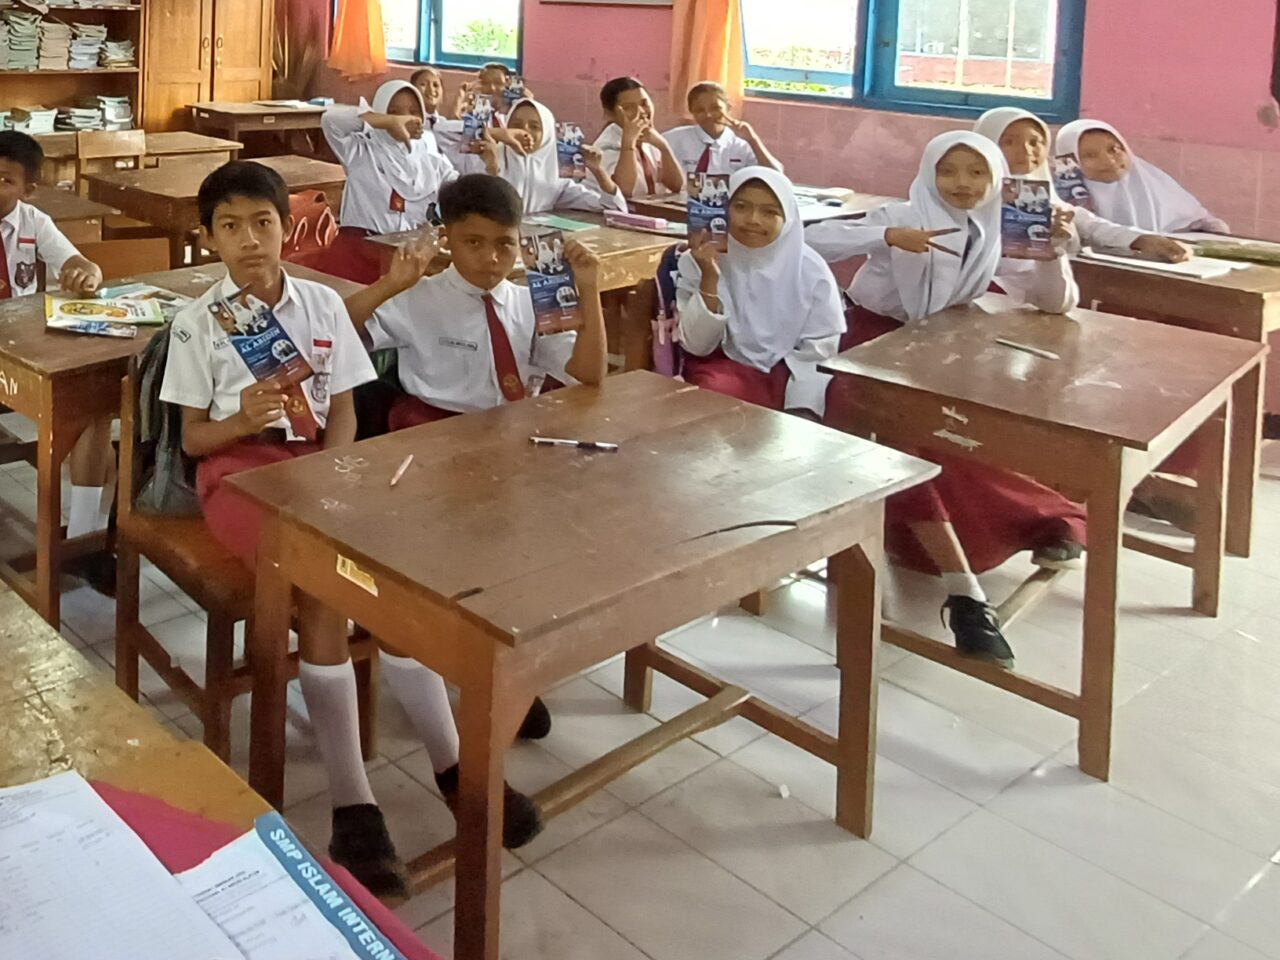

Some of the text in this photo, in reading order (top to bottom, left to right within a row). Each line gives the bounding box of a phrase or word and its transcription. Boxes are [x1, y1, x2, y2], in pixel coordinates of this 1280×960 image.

[270, 828, 396, 960] SMP ISLAM INTERN
